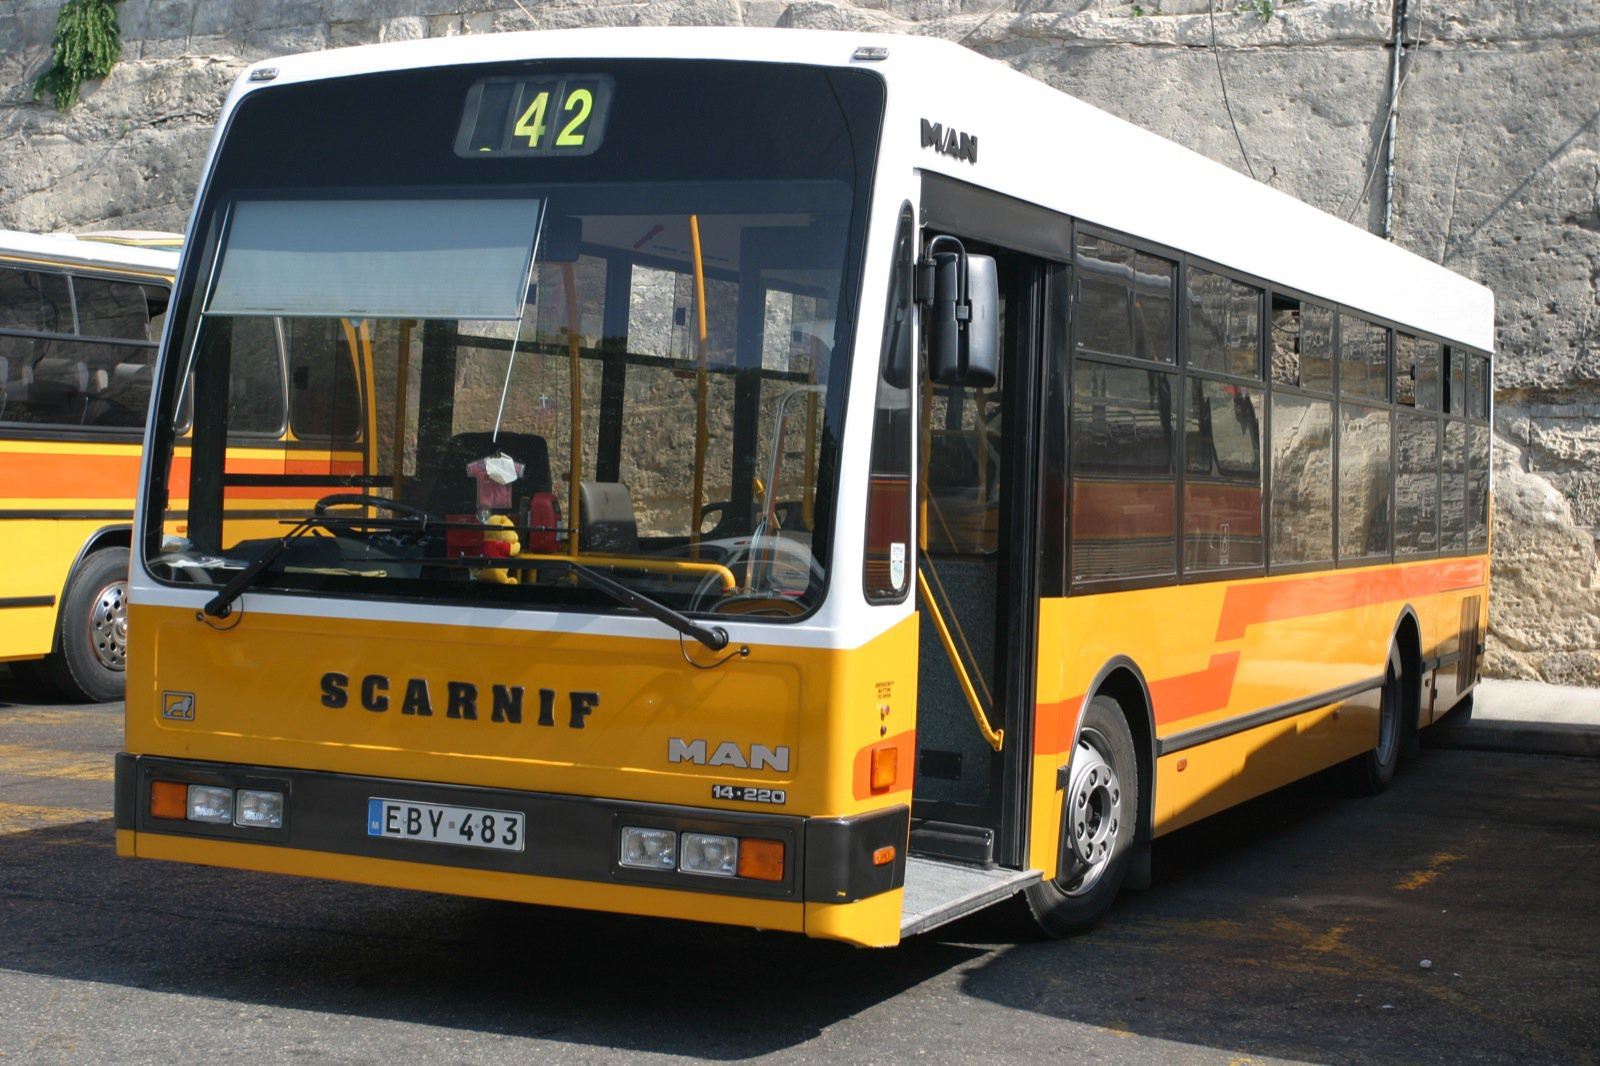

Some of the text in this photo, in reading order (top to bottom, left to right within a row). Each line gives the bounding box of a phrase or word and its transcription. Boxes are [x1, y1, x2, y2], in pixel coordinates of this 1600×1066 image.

[513, 88, 593, 147] 42
[920, 117, 977, 165] MAN
[320, 671, 600, 729] SCARNIF
[668, 737, 789, 772] MAN
[386, 805, 518, 845] EBY 483
